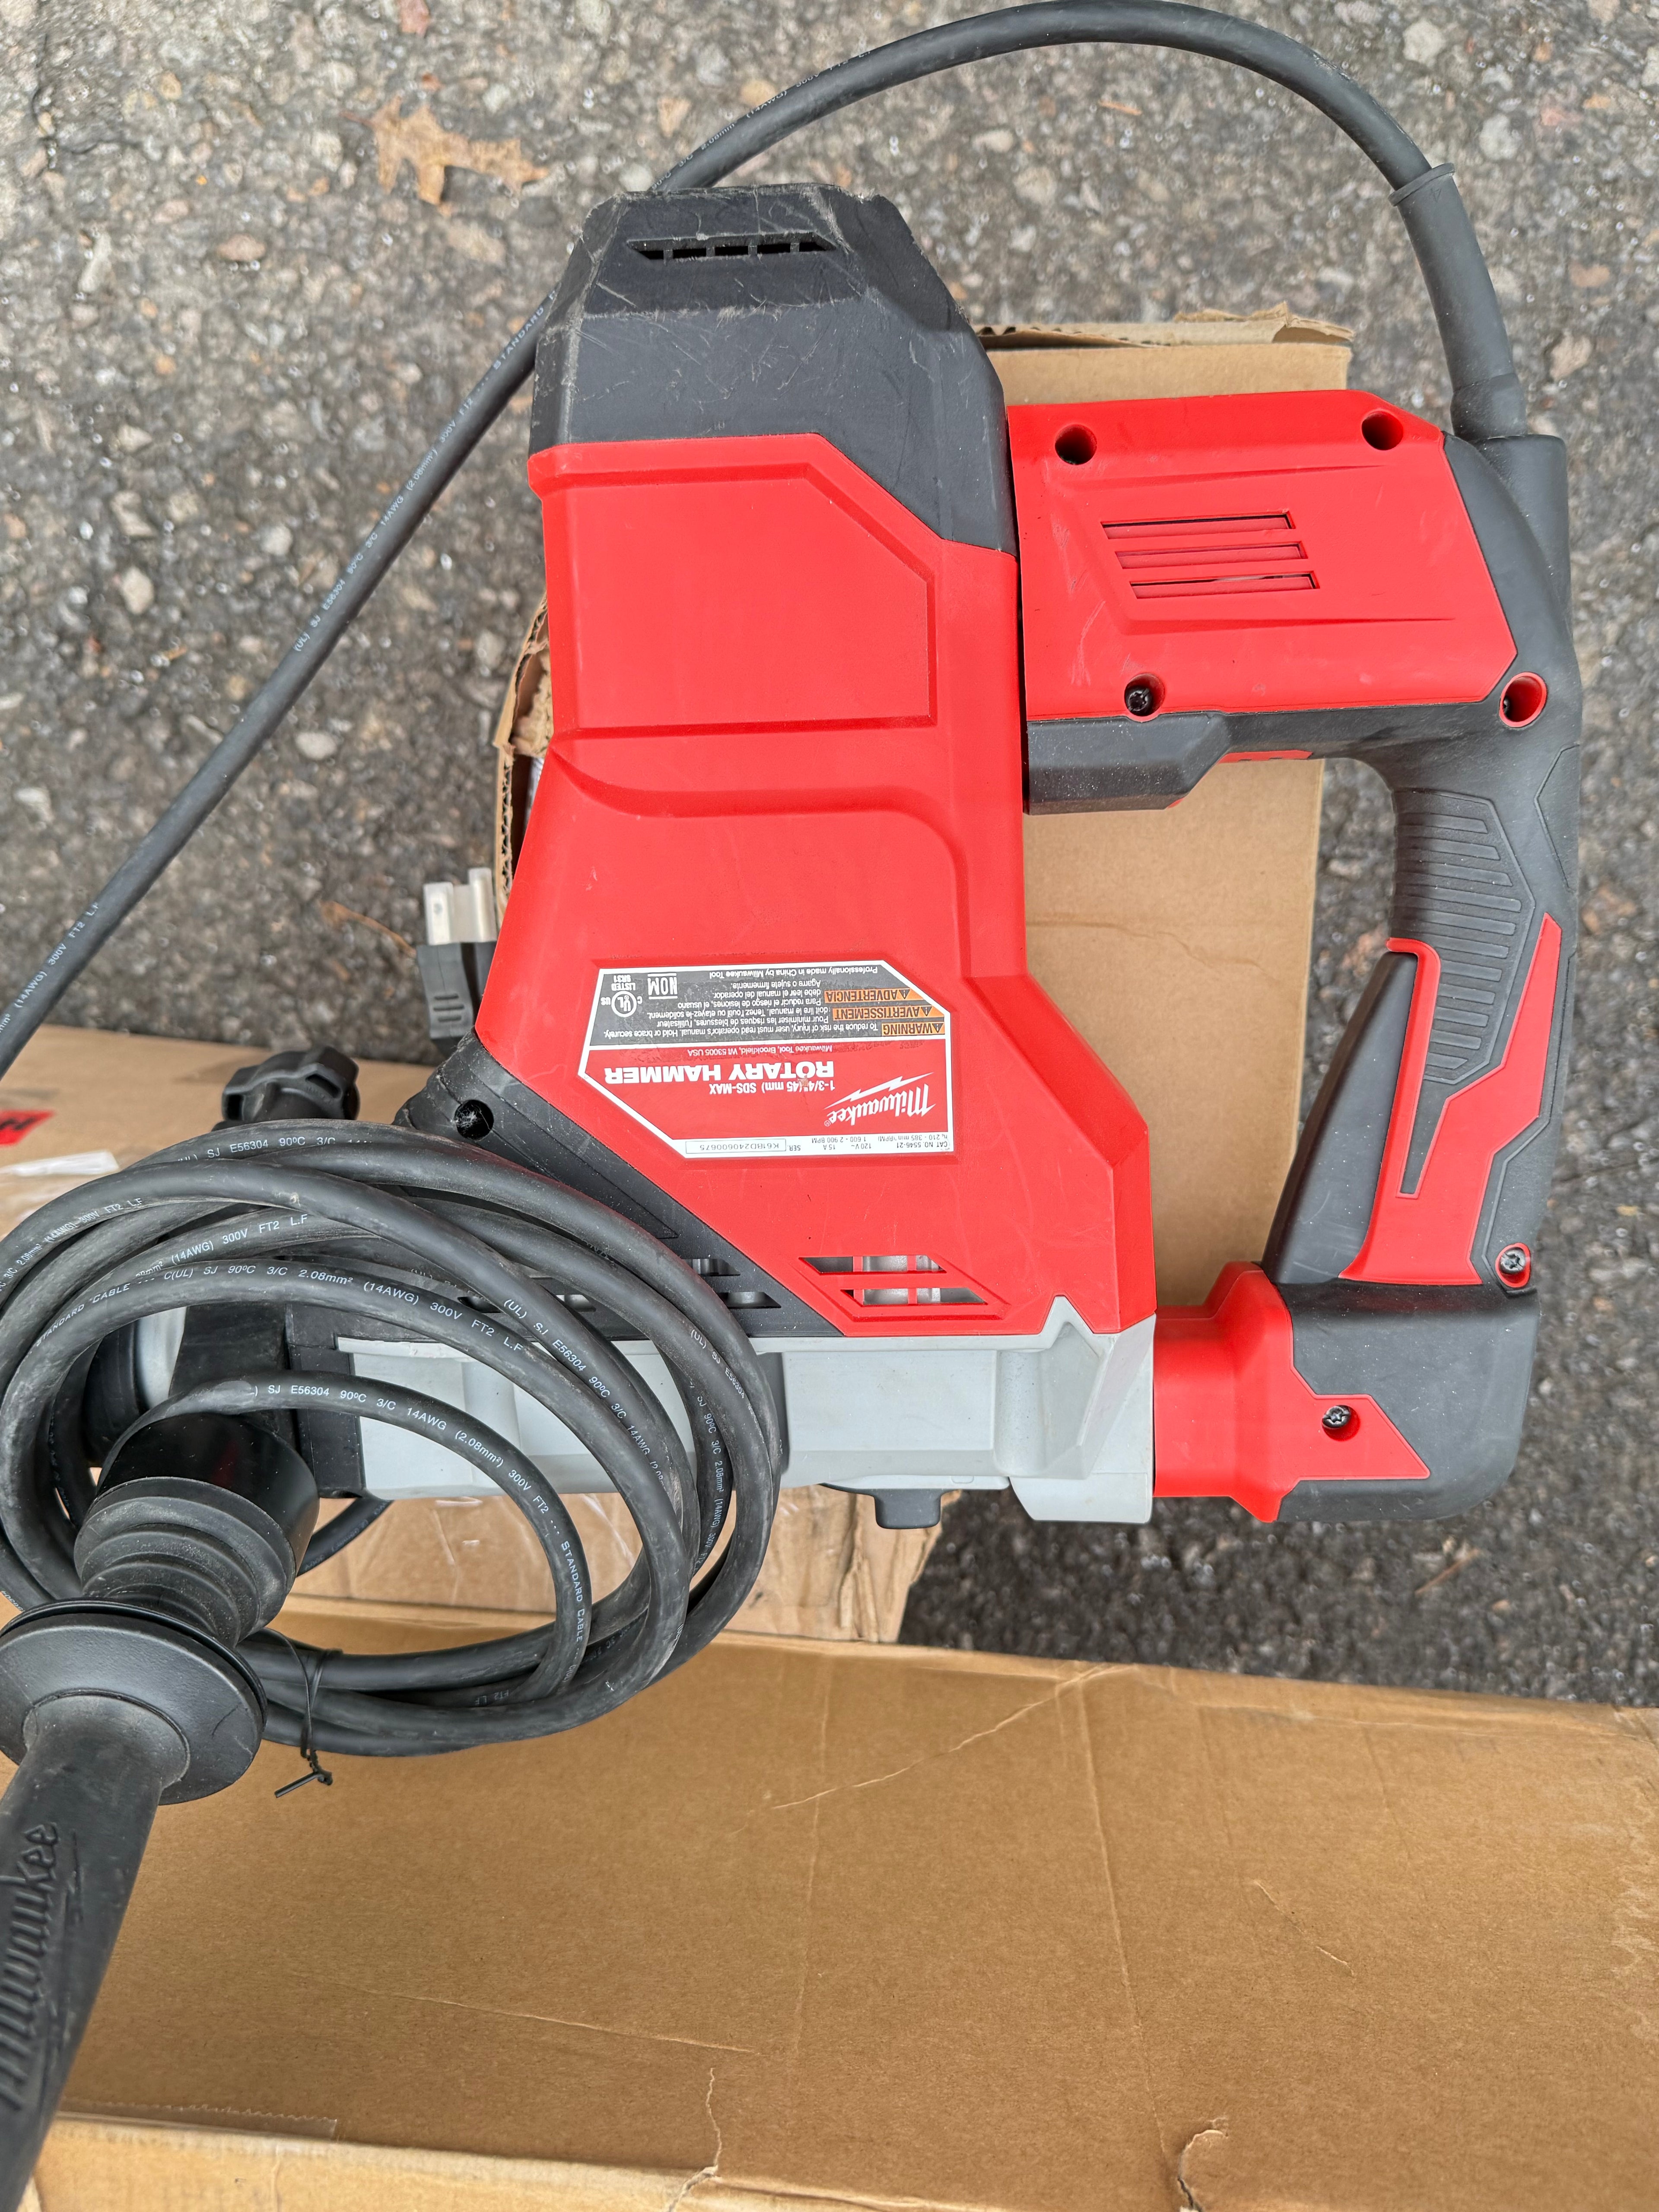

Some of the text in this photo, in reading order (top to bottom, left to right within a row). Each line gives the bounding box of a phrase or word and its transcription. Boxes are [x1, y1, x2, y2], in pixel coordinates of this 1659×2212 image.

[493, 307, 544, 370] STANDARD
[13, 902, 99, 1008] (14AWG) 300V FT2 L.F
[726, 970, 764, 979] Milwaukee
[765, 968, 774, 977] by
[828, 966, 877, 976] Professionally
[611, 982, 636, 991] LISTED
[647, 977, 677, 995] NOM
[731, 982, 769, 990] firmemente.
[771, 979, 791, 988] sujete
[799, 979, 821, 988] Agarre
[712, 989, 743, 1000] operador.
[756, 990, 781, 999] manual
[790, 989, 802, 998] leer
[804, 989, 821, 997] debe
[826, 989, 898, 1002] ADVERTENCIA
[600, 997, 611, 1005] US
[617, 997, 631, 1011] UL
[711, 1000, 740, 1009] lesiones,
[752, 998, 772, 1007] riesgo
[647, 1011, 684, 1020] solidement.
[746, 1009, 766, 1017] Tenez
[767, 1008, 794, 1017] manual.
[804, 1007, 814, 1016] lire
[815, 1007, 828, 1015] doit
[834, 1007, 920, 1020] AVERTISSEMENT
[694, 1018, 728, 1027] blessures,
[740, 1016, 765, 1026] risques
[766, 1017, 776, 1025] les
[811, 1015, 829, 1023] Pour
[791, 1023, 810, 1033] injury,
[811, 1025, 819, 1033] of
[820, 1024, 832, 1033] risk
[833, 1024, 844, 1032] the
[845, 1023, 868, 1032] reduce
[870, 1023, 878, 1031] To
[883, 1023, 932, 1035] WARNING
[604, 1029, 633, 1039] securely.
[663, 1029, 678, 1037] Hold
[680, 1028, 706, 1036] manual.
[739, 1046, 776, 1055] Brookfield,
[777, 1046, 794, 1054] Tool,
[604, 1061, 834, 1084] ROTARY HAMMER
[709, 1082, 756, 1095] SDS-MAX
[761, 1082, 784, 1094] mm)
[207, 1147, 220, 1158] SJ
[230, 1139, 269, 1153] E56304
[3, 1268, 18, 1278] 3/C
[43, 1221, 78, 1243] (14AWG)
[79, 1211, 101, 1224] 300V
[104, 1204, 124, 1214] FT2
[127, 1198, 143, 1207] L.F
[171, 1214, 308, 1265] (14AWG) 300V FT2 L.F
[36, 1303, 85, 1347] STANDARD
[92, 1283, 131, 1304] CABLE
[164, 1268, 194, 1280] C(UL)
[203, 1266, 218, 1274] SJ
[267, 1266, 288, 1276] 3/C
[363, 1281, 420, 1305] (14AWG)
[430, 1302, 463, 1320] 300V
[471, 1319, 495, 1337] FT2
[503, 1336, 524, 1351] L.F
[691, 1329, 707, 1349] (UL)
[712, 1351, 721, 1364] SJ
[504, 1299, 527, 1319] (UL)
[534, 1322, 549, 1335] SJ
[552, 1339, 587, 1371] E56304
[611, 1403, 626, 1419] 3/C
[627, 1425, 651, 1455] 14AWG
[711, 1440, 721, 1455] 3/C
[268, 1385, 280, 1394] SJ
[291, 1385, 330, 1397] E56304
[376, 1398, 397, 1411] 3/C
[407, 1407, 447, 1431] 14AWG
[509, 1469, 532, 1491] 300V
[532, 1494, 550, 1514] FT2
[561, 1541, 583, 1602] STANDARD
[576, 1608, 585, 1642] CABLE
[710, 1498, 724, 1528] (14AWG)
[705, 1532, 716, 1548] 300V
